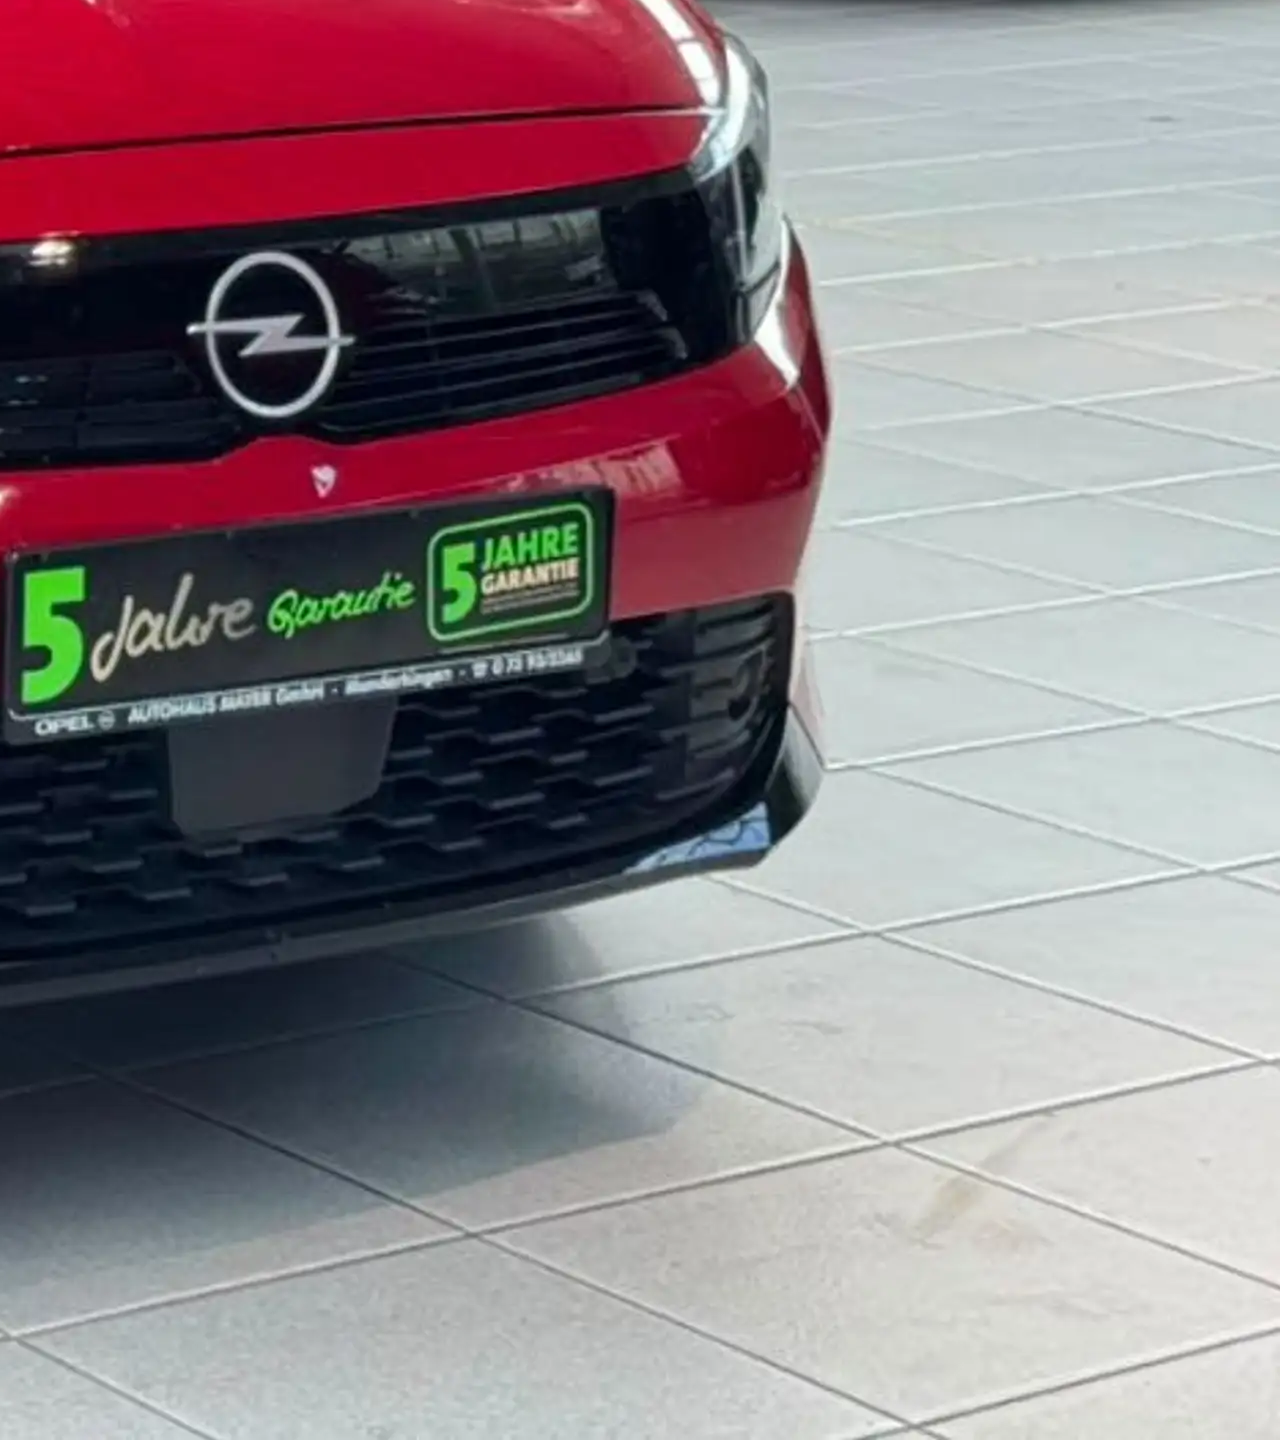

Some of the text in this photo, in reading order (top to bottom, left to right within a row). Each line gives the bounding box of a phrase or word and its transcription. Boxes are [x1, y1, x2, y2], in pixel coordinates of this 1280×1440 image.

[441, 541, 478, 625] 5
[480, 521, 580, 573] JAHRE
[480, 557, 581, 595] GARANTIE
[21, 566, 85, 704] 5
[89, 572, 259, 682] Jahre
[34, 716, 95, 736] OPEL
